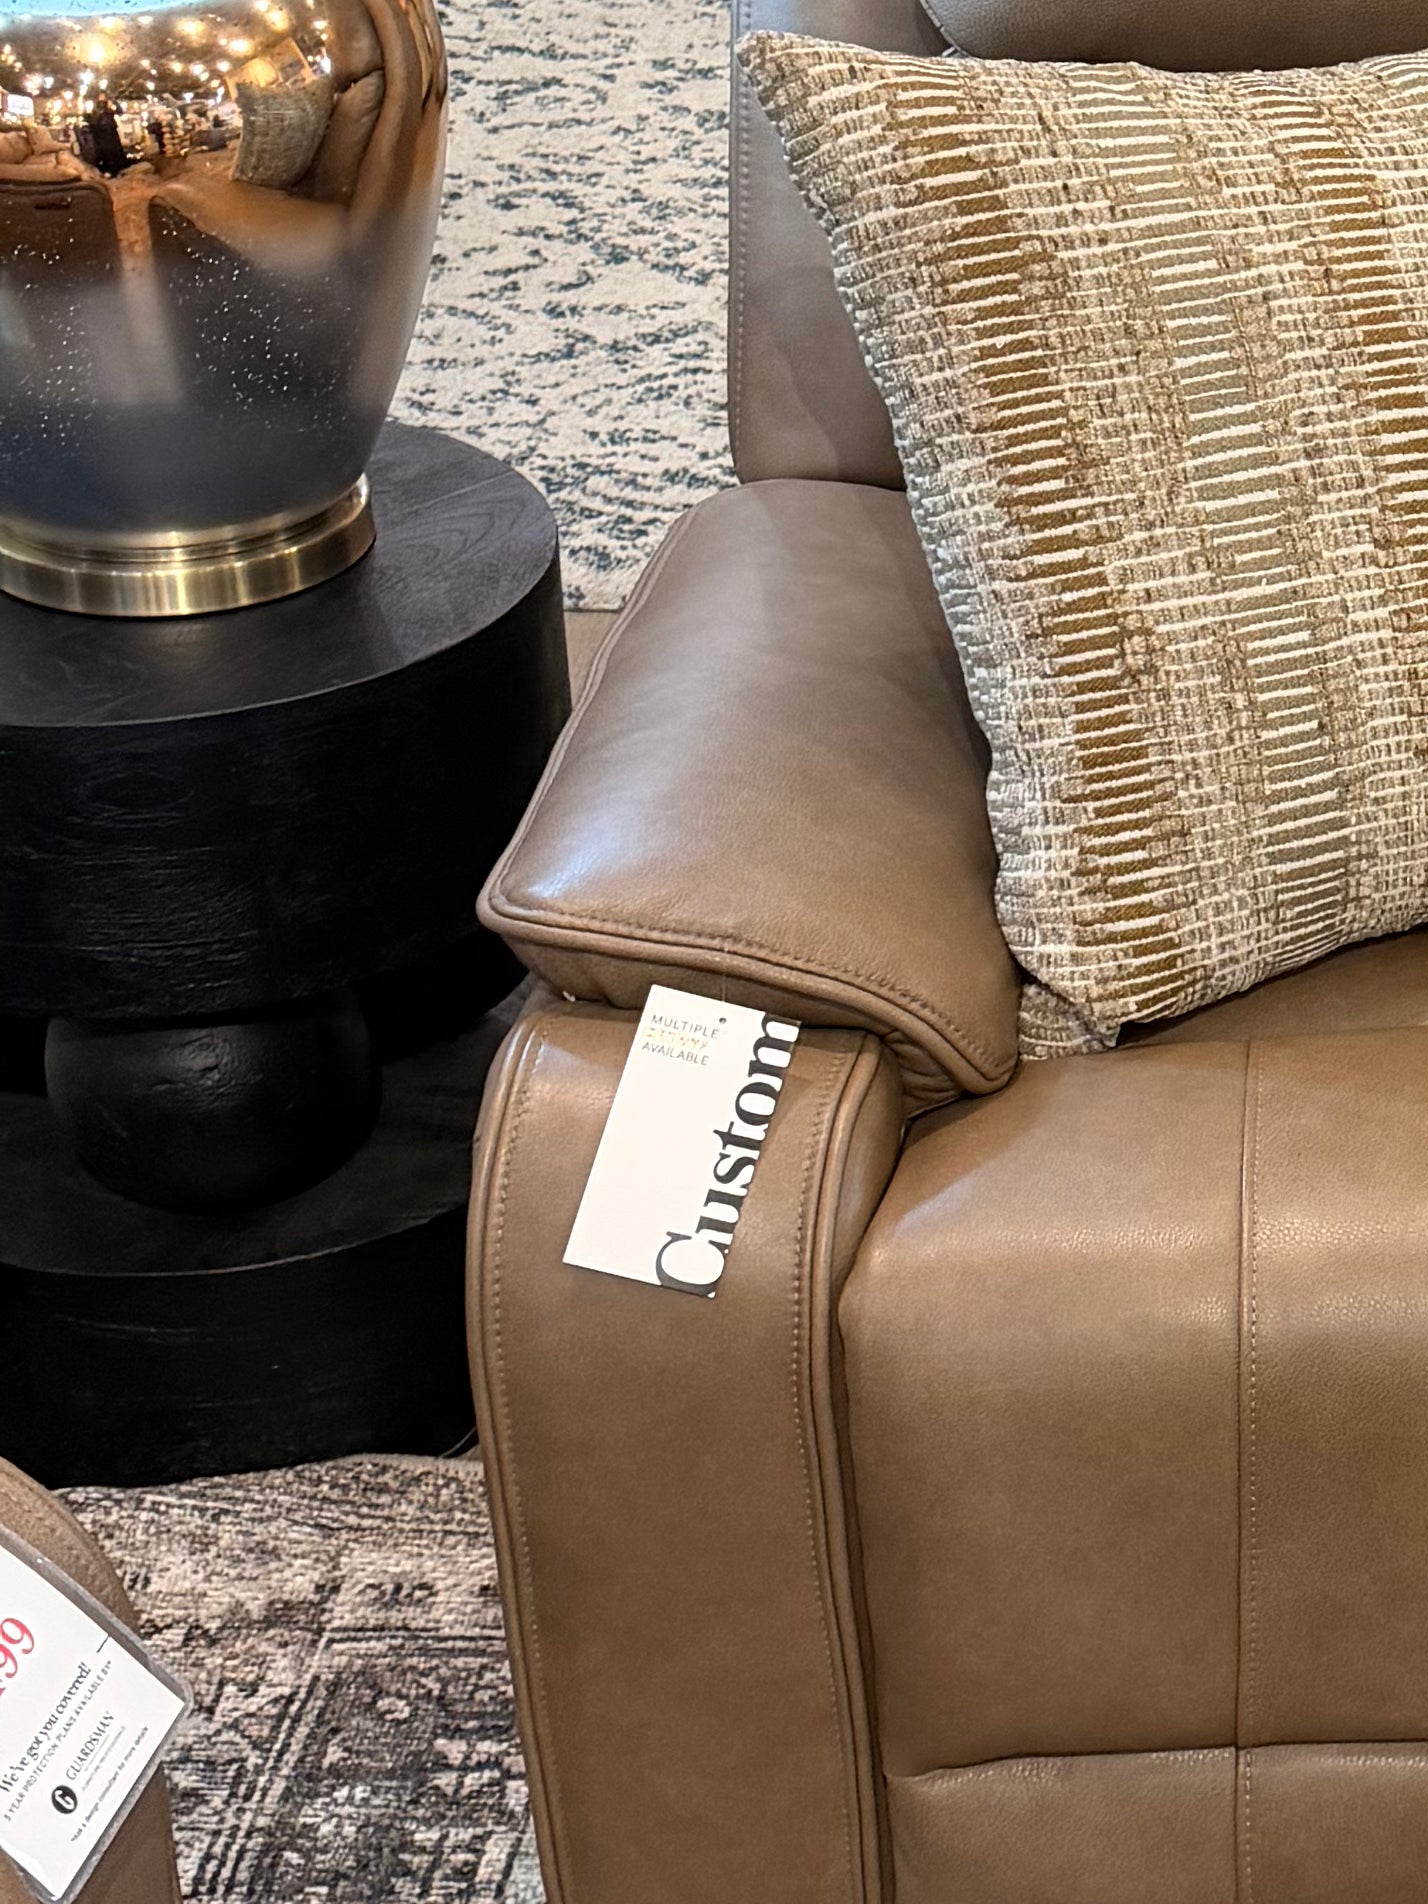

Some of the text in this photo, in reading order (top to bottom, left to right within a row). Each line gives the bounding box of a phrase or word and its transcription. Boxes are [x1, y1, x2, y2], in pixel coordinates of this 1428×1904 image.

[641, 1041, 709, 1066] AVAILABLE
[650, 1013, 719, 1039] MULTIPLE
[656, 1013, 802, 1299] Custom
[8, 1791, 26, 1814] YEAR
[22, 1741, 59, 1792] PROTECTION
[55, 1714, 77, 1743] PLANS
[72, 1673, 104, 1716] AVAILABLE
[24, 1735, 45, 1760] got
[39, 1712, 59, 1739] you
[54, 1661, 91, 1714] covered!
[64, 1710, 114, 1780] GUARDSMAN
